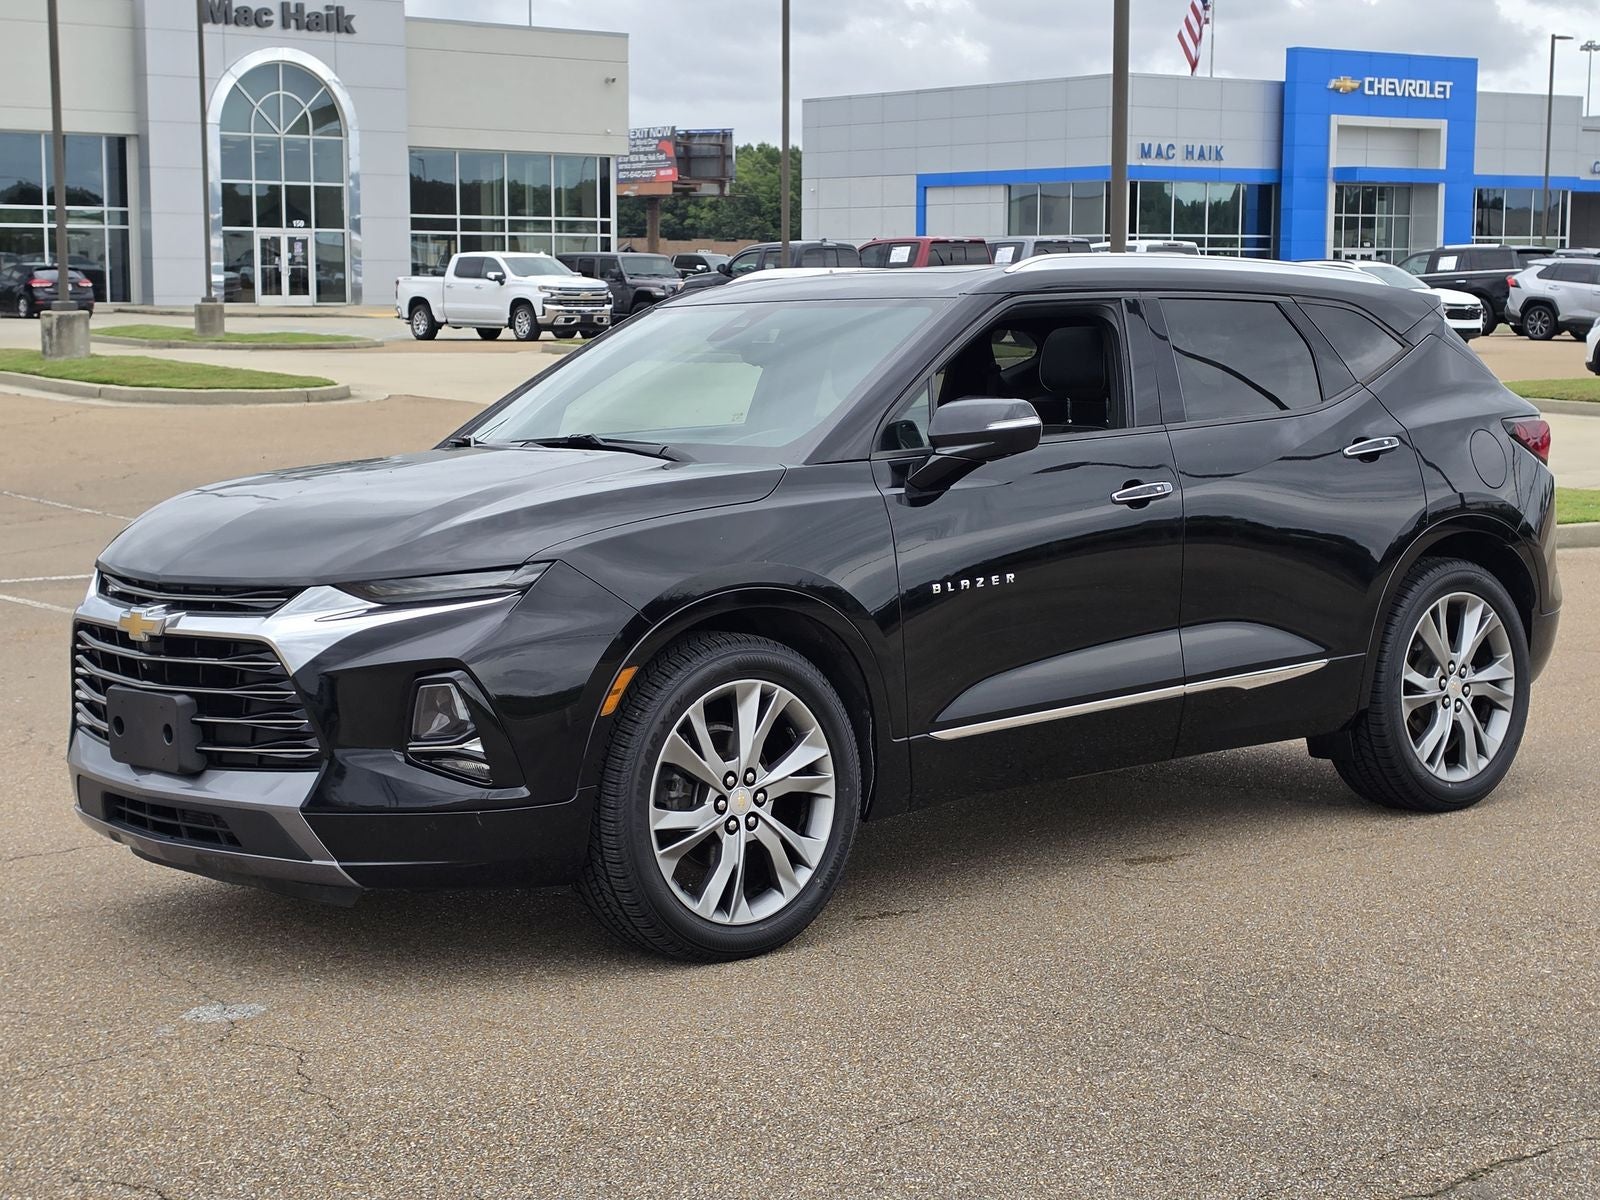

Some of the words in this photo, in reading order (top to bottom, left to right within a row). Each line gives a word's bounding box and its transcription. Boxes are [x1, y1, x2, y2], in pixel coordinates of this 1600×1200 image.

[203, 0, 274, 28] Mac
[281, 1, 357, 34] Haik
[1364, 77, 1454, 100] CHEVROLET
[629, 129, 649, 138] EXIT
[650, 126, 671, 136] NOW
[1139, 142, 1176, 160] MAC
[1184, 144, 1224, 162] HAIK
[932, 573, 1015, 594] BLAZER
[818, 814, 853, 890] YOKOHAMA
